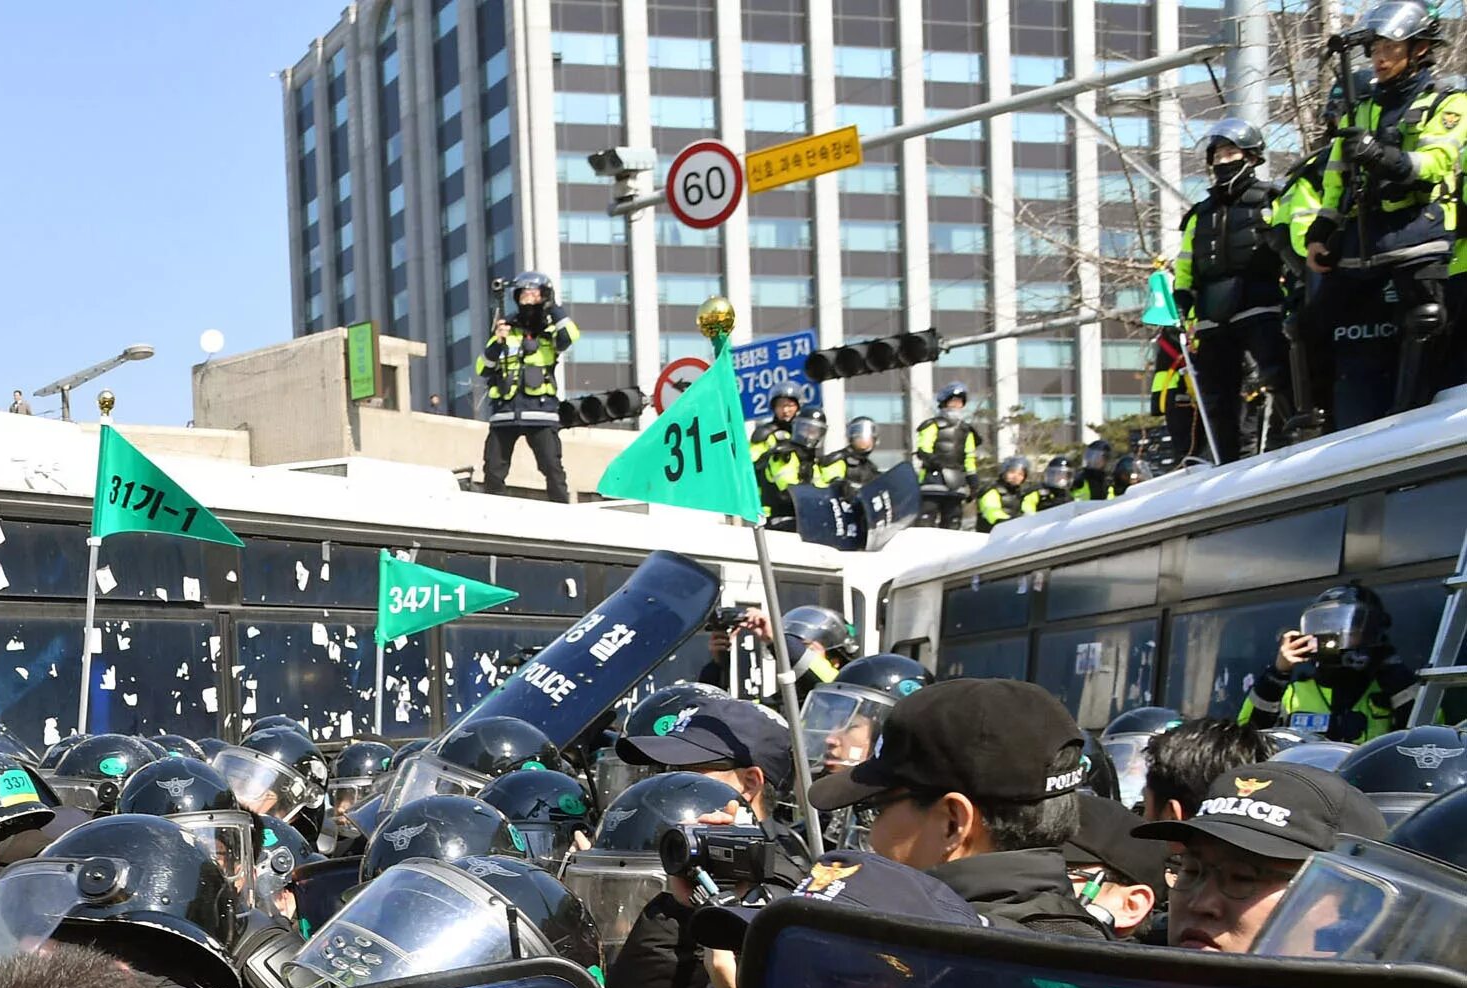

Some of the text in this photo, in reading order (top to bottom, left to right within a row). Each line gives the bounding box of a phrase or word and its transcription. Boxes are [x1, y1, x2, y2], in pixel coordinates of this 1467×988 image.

[683, 166, 726, 206] 60
[777, 337, 812, 361] 금지
[109, 474, 199, 532] 31기-1
[388, 584, 466, 613] 34기-1
[518, 662, 577, 702] POLICE
[1045, 766, 1084, 791] POLIC
[1196, 797, 1291, 827] POLICE
